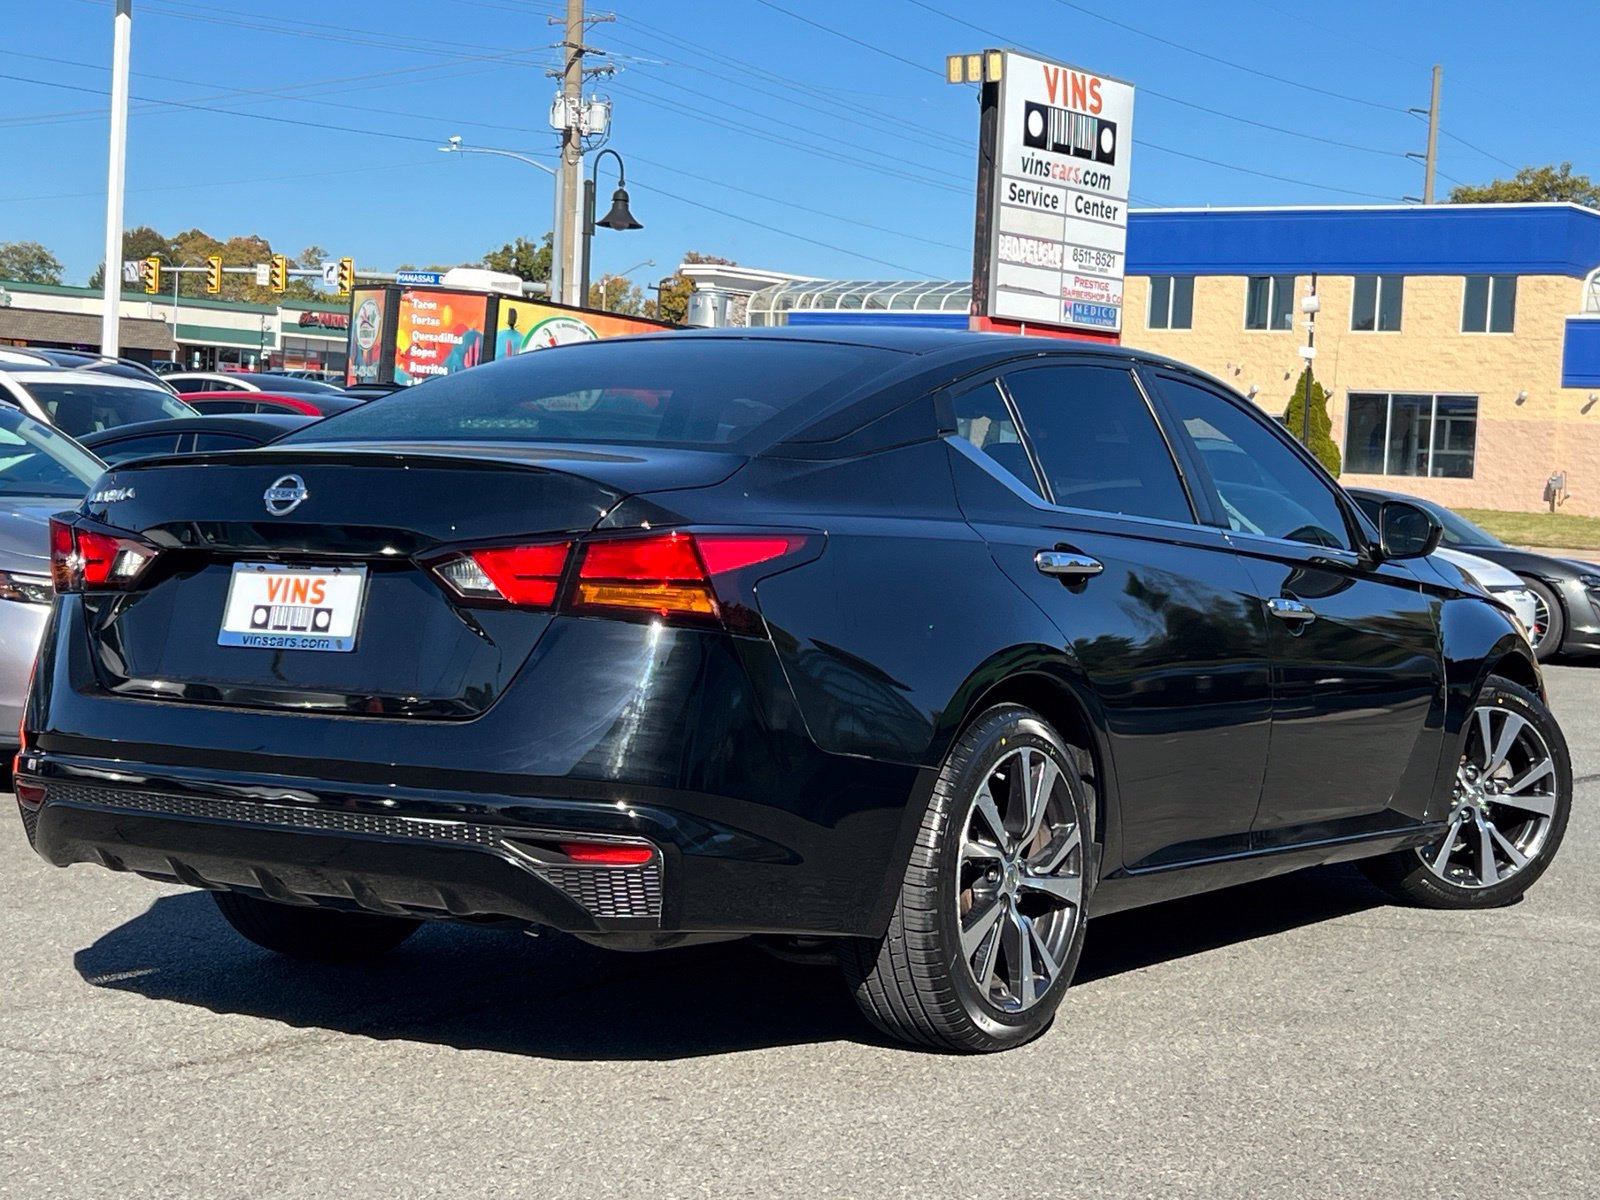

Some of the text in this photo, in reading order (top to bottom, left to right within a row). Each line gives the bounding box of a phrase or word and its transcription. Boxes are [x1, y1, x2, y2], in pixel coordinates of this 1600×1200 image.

[1043, 65, 1103, 115] VINS
[1021, 152, 1111, 191] vinscars.com
[1008, 182, 1119, 221] Service Center
[1072, 248, 1116, 268] 8511-8521
[398, 274, 435, 283] MANASSAS
[1074, 276, 1110, 292] PRESTIGE
[1062, 287, 1105, 301] BARBERSHOP
[1106, 293, 1111, 302] &
[411, 299, 437, 309] Tacos
[1075, 303, 1115, 318] MEDICO
[411, 313, 440, 326] Tortas
[411, 330, 464, 345] Quesadillas
[410, 345, 437, 358] Sopes
[409, 361, 449, 376] Burritos
[266, 576, 327, 605] VINS
[242, 635, 330, 649] vinscars.com
